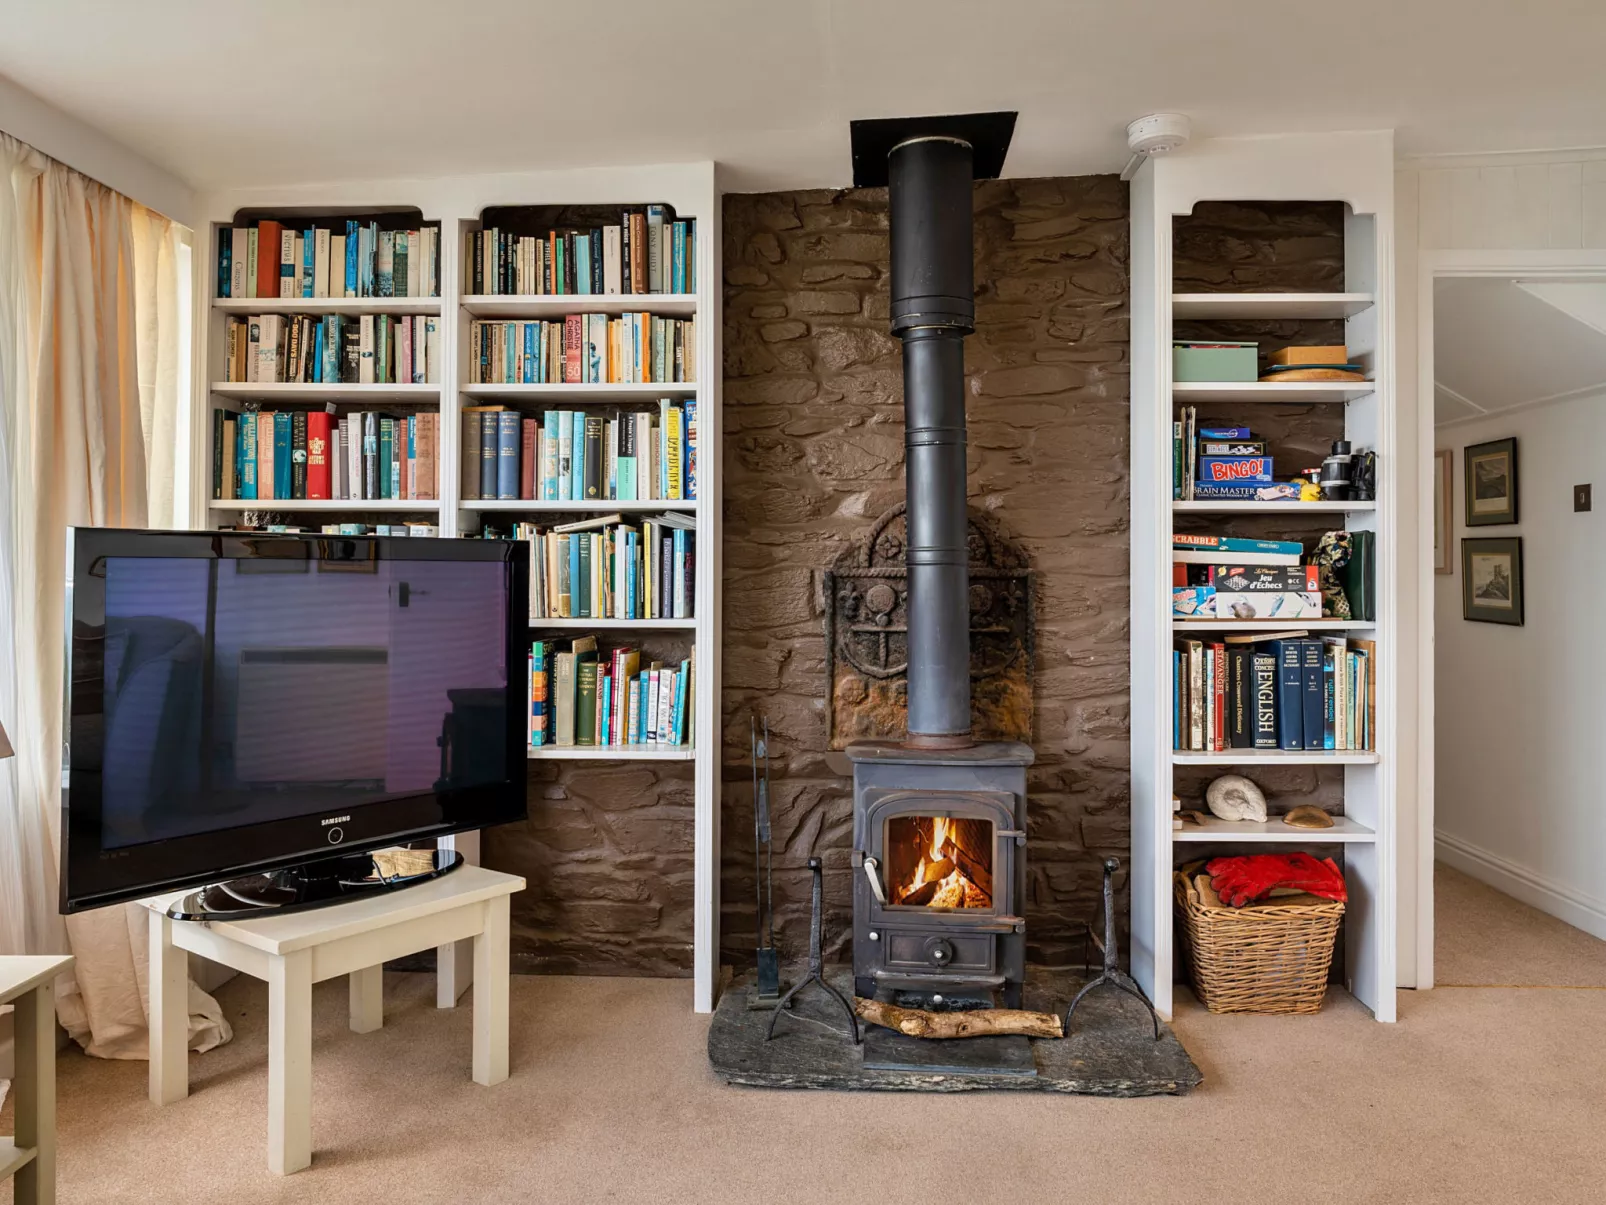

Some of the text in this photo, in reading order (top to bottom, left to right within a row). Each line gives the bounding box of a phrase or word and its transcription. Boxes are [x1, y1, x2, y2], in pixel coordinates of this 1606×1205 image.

[234, 262, 244, 290] Citizens
[294, 416, 298, 425] OF
[1211, 458, 1264, 482] BINGO!
[1258, 672, 1274, 732] ENGLISH
[321, 815, 350, 826] SAMSUNG
